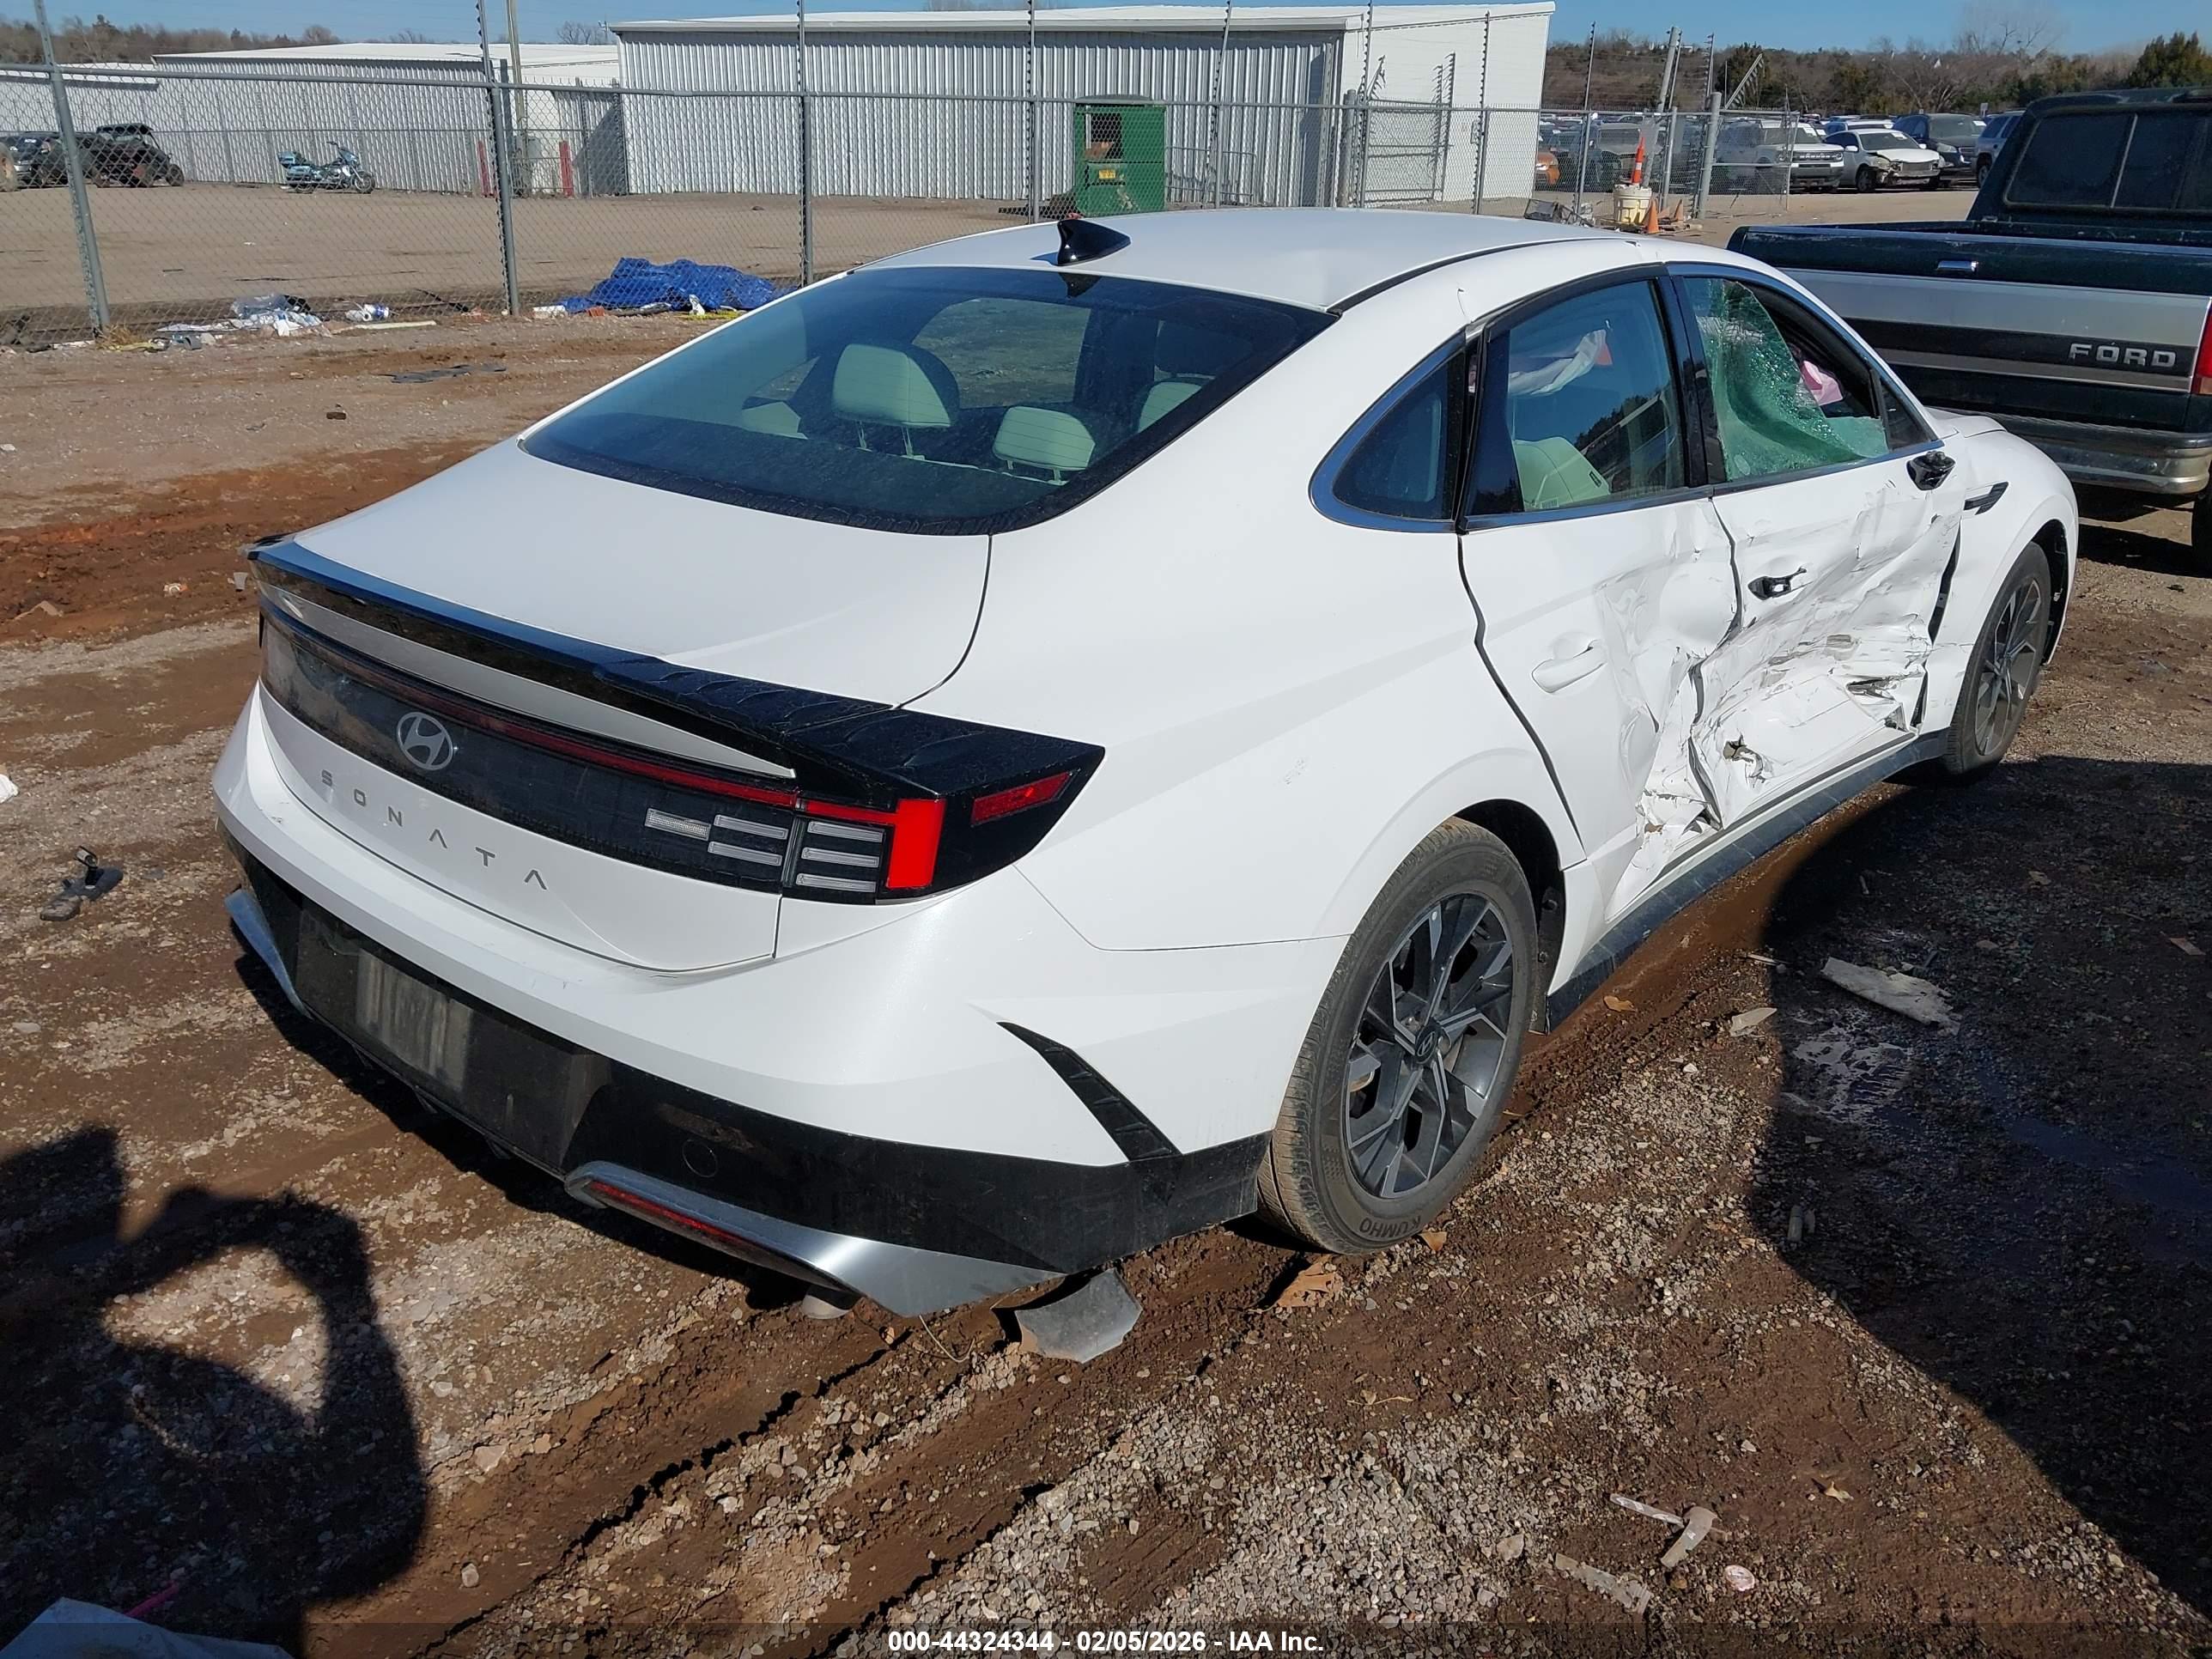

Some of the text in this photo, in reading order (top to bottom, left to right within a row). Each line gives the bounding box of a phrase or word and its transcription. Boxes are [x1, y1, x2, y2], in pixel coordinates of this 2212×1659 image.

[2069, 343, 2176, 368] FORD
[321, 770, 547, 890] SONATA
[1360, 1216, 1420, 1237] KUMHO
